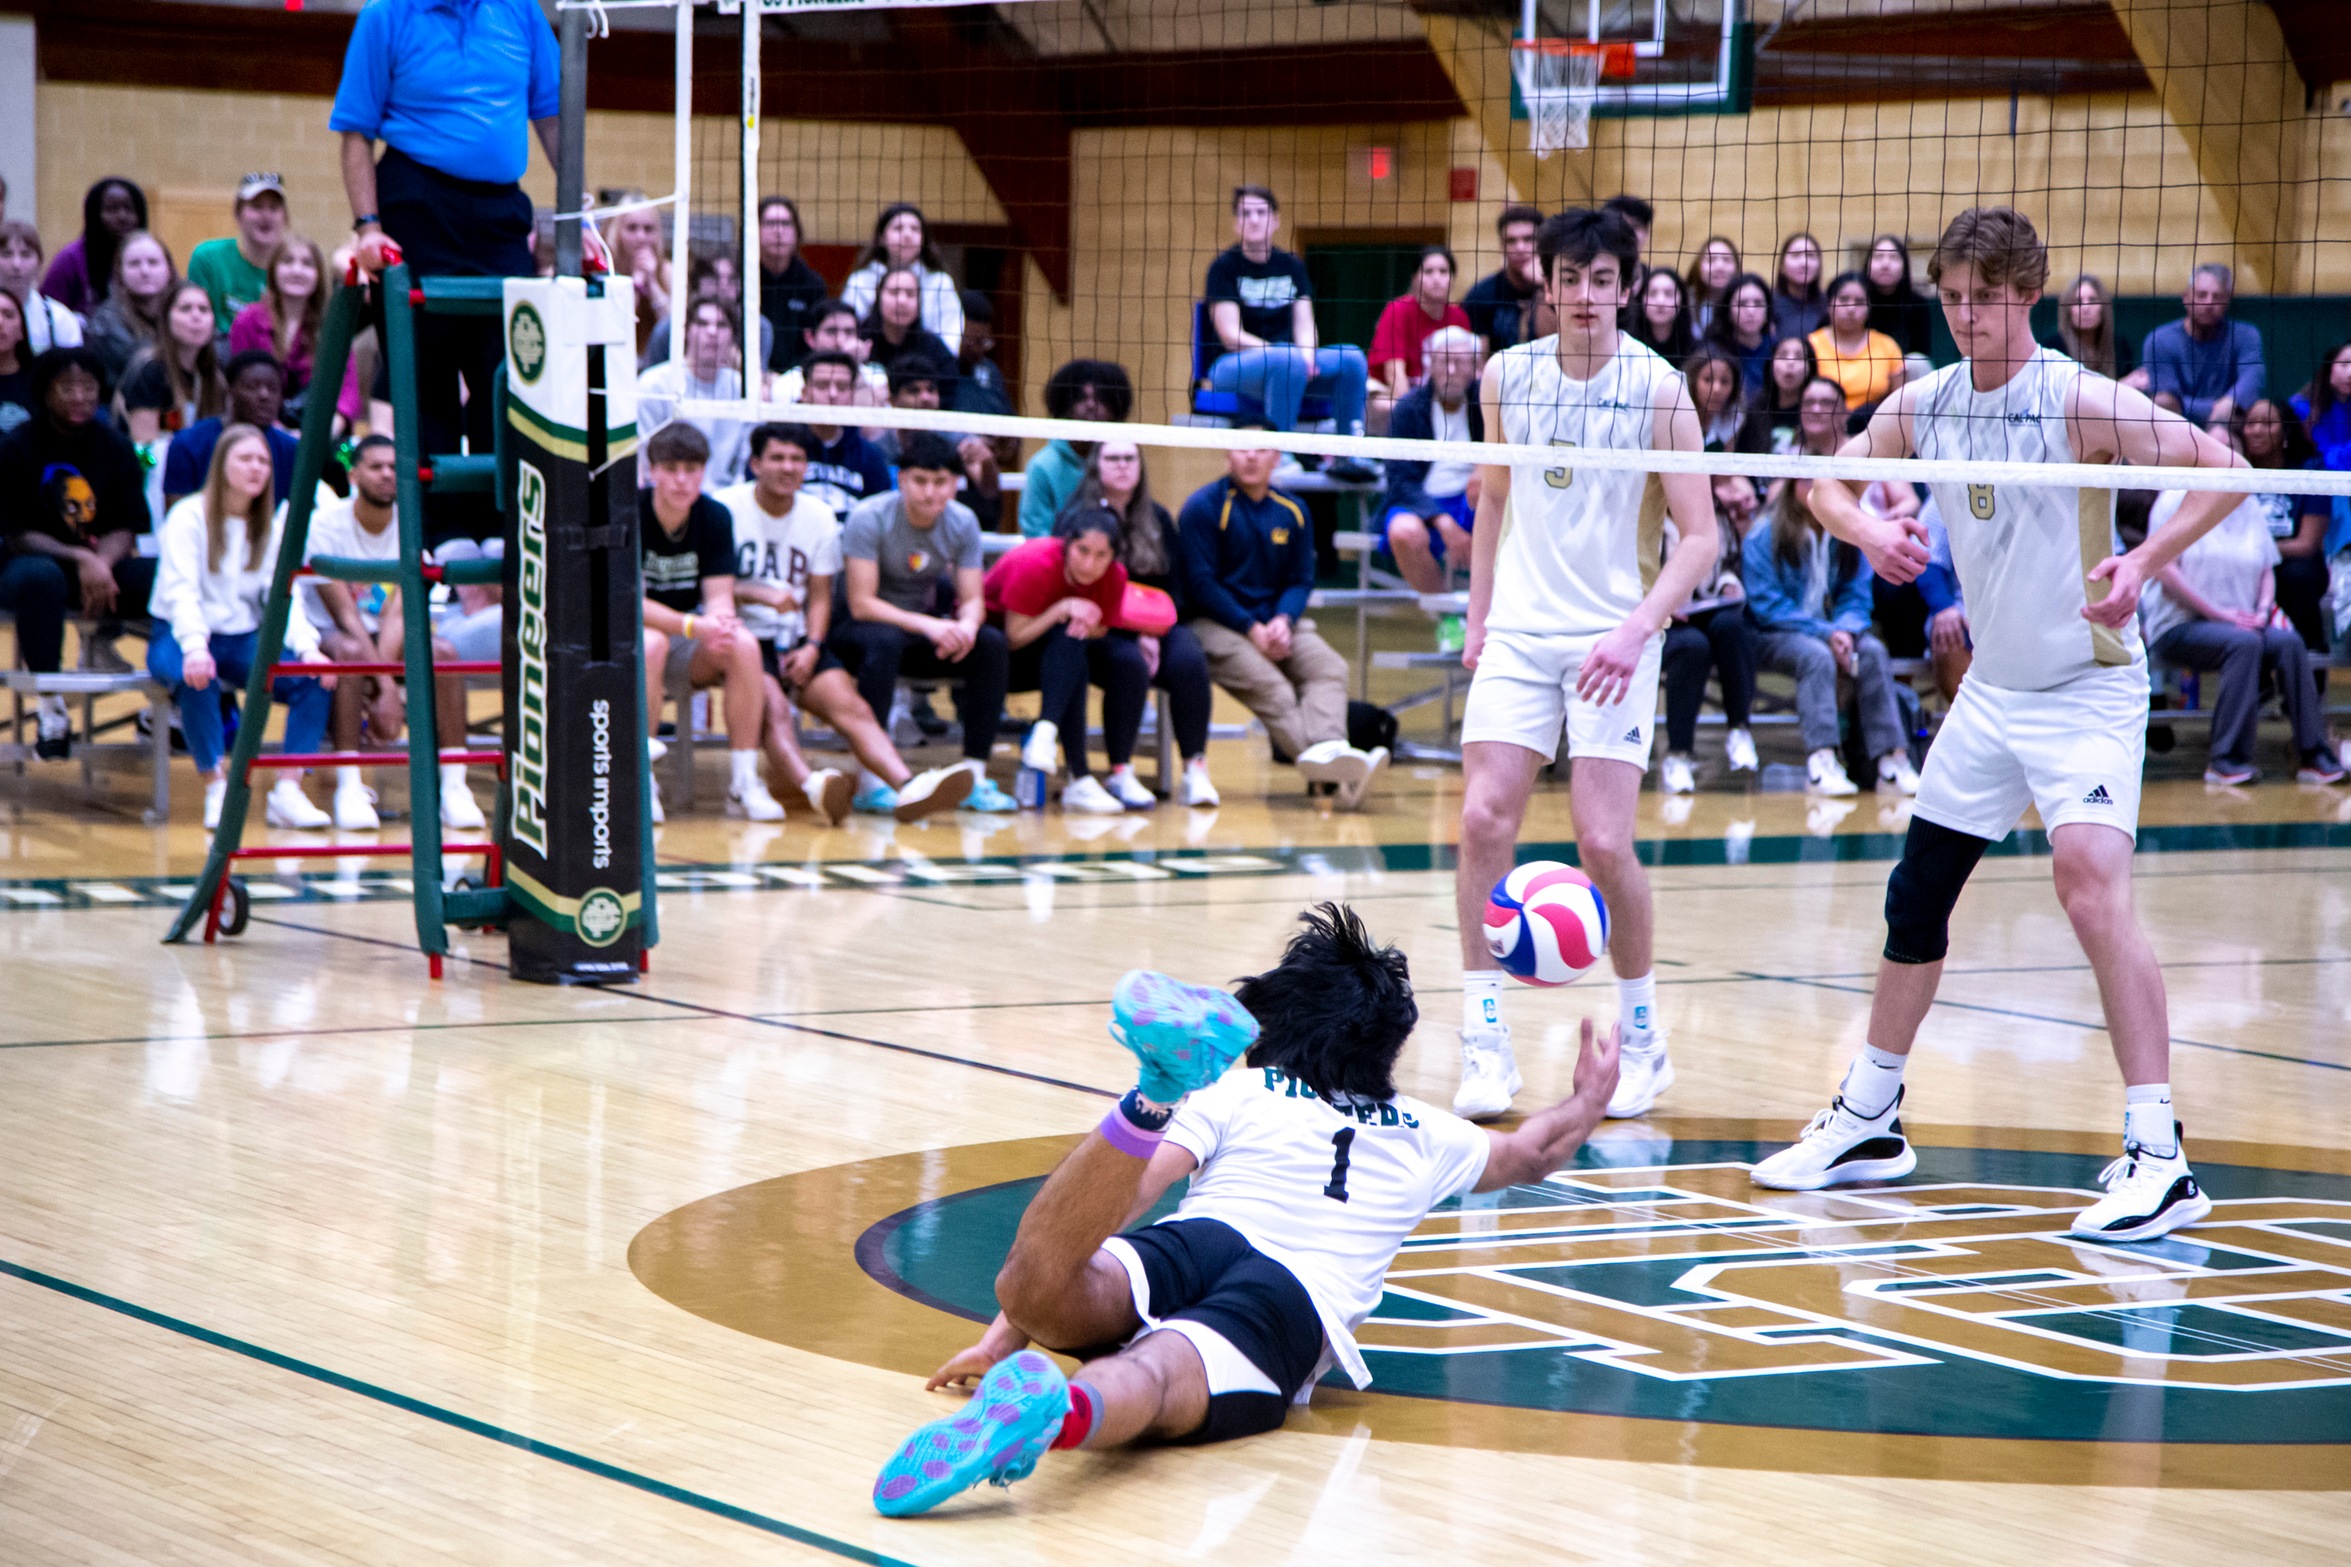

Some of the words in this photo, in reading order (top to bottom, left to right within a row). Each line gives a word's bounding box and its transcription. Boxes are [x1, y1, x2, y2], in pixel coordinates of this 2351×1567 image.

[1968, 483, 1995, 520] 8
[512, 458, 549, 861] Pioneers
[589, 699, 612, 775] sports
[588, 777, 612, 869] imports
[1323, 1126, 1356, 1205] 1
